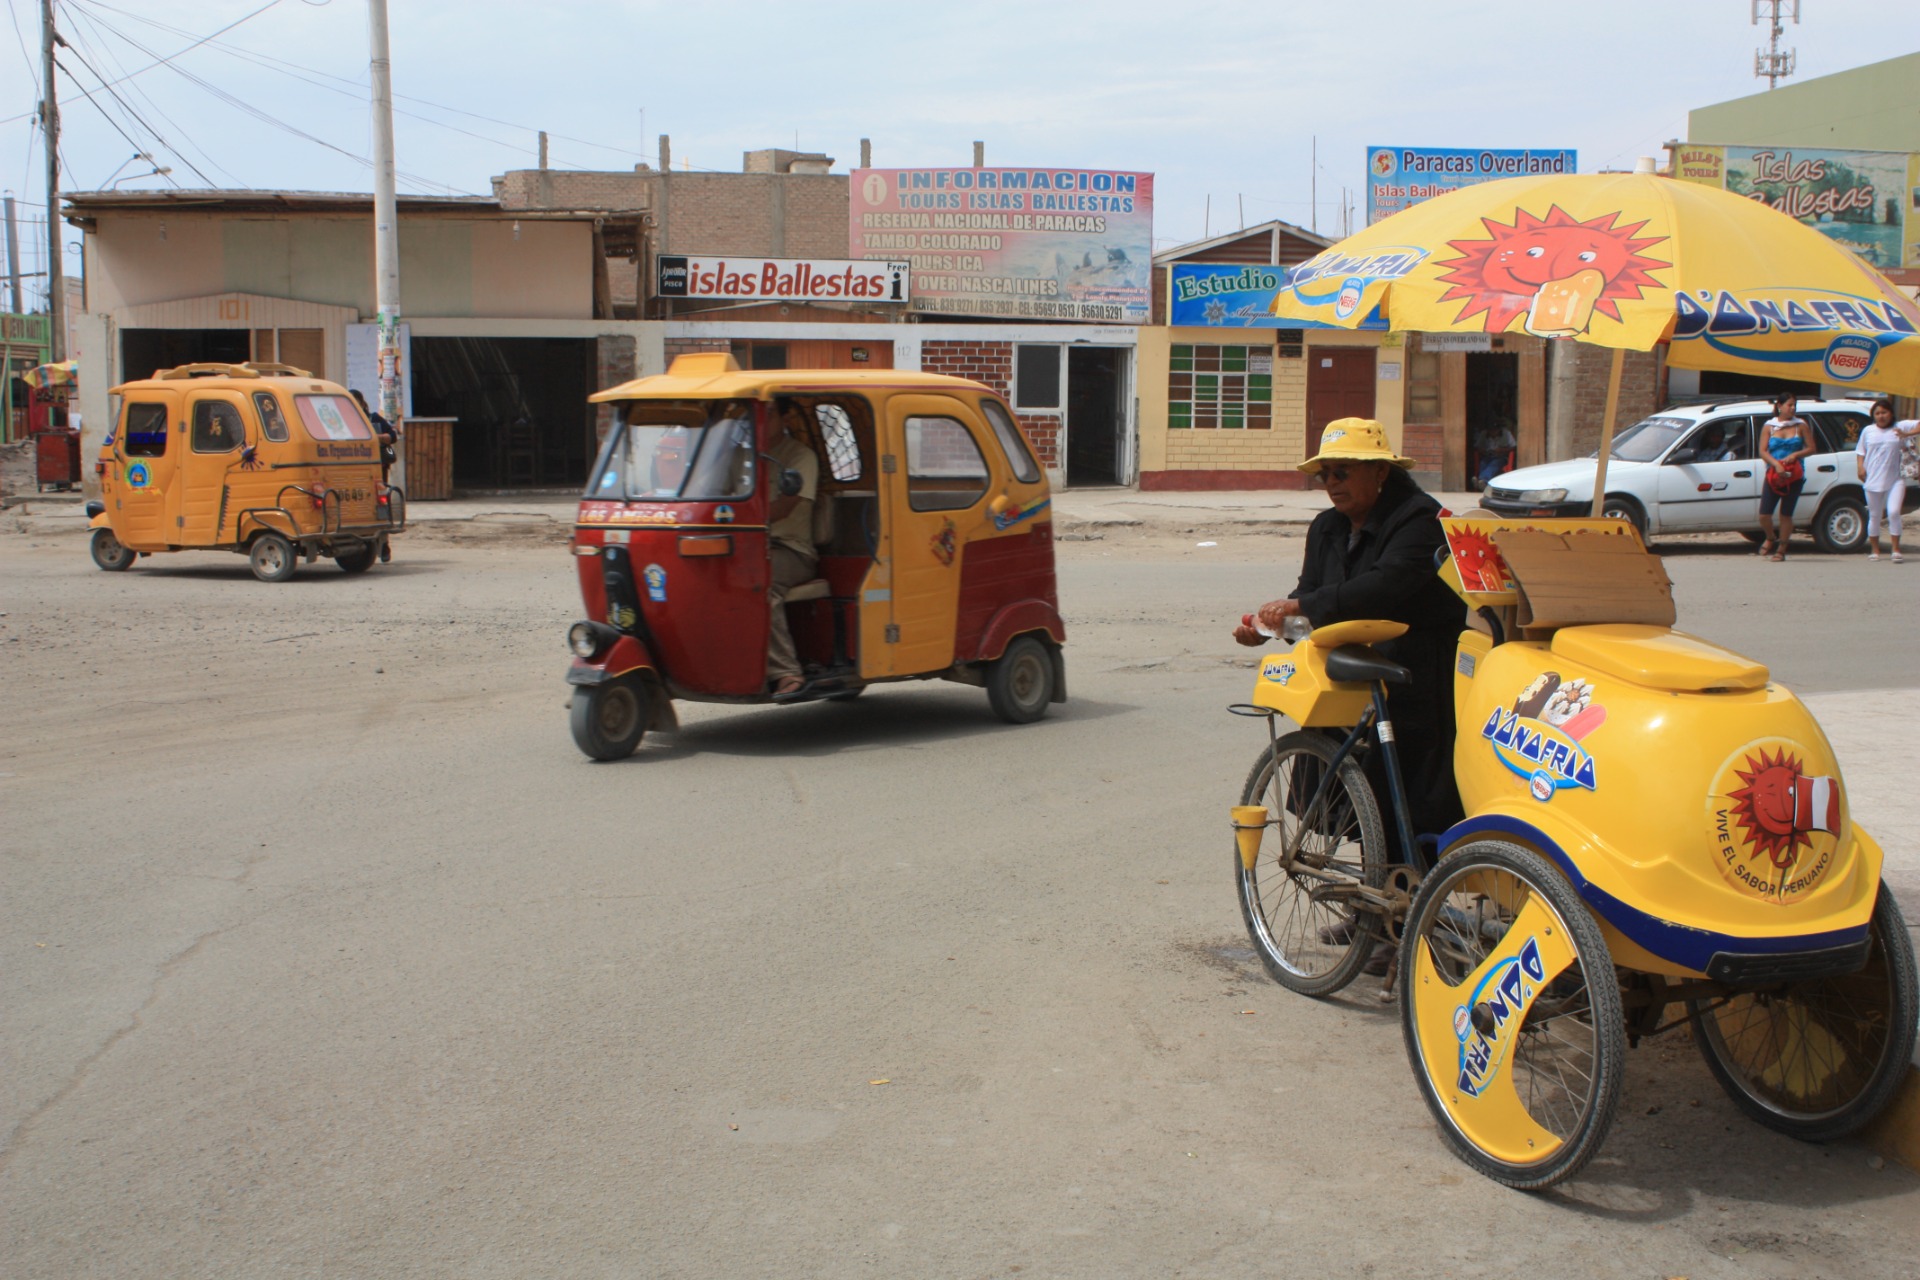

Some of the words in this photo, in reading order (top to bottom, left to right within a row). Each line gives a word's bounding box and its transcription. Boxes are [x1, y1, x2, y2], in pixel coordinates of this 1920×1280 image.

[1403, 151, 1474, 172] Paracas
[1479, 151, 1565, 173] Overland
[1752, 151, 1826, 185] Islas
[898, 171, 1136, 193] INFORMACION
[1683, 167, 1719, 178] TOURS
[1374, 184, 1406, 197] Islas
[899, 192, 961, 209] TOURS
[969, 193, 1024, 210] ISLAS
[1032, 194, 1134, 213] BALLESTAS
[1375, 199, 1399, 207] Tours
[863, 213, 930, 229] RESERVA
[934, 213, 1011, 230] NACIONAL
[1013, 214, 1032, 230] DE
[1035, 215, 1106, 233] PARACAS
[863, 234, 917, 249] TAMBO
[920, 234, 1002, 250] COLORADO
[887, 263, 908, 272] Free
[956, 256, 984, 272] ICA
[689, 261, 757, 295] islas
[760, 262, 885, 297] Ballestas
[918, 275, 959, 291] OVER
[961, 276, 1015, 294] NASCA
[1016, 278, 1058, 296] LINES
[1177, 267, 1277, 301] Estudio
[1058, 303, 1075, 317] 9513
[1105, 305, 1123, 320] 5291
[1450, 335, 1478, 344] OVERLAND
[1841, 338, 1872, 349] HELADOS
[1716, 809, 1730, 843] VIVE
[1722, 846, 1737, 866] EL
[1734, 864, 1776, 896] SABOR
[1783, 852, 1829, 894] PERUANO
